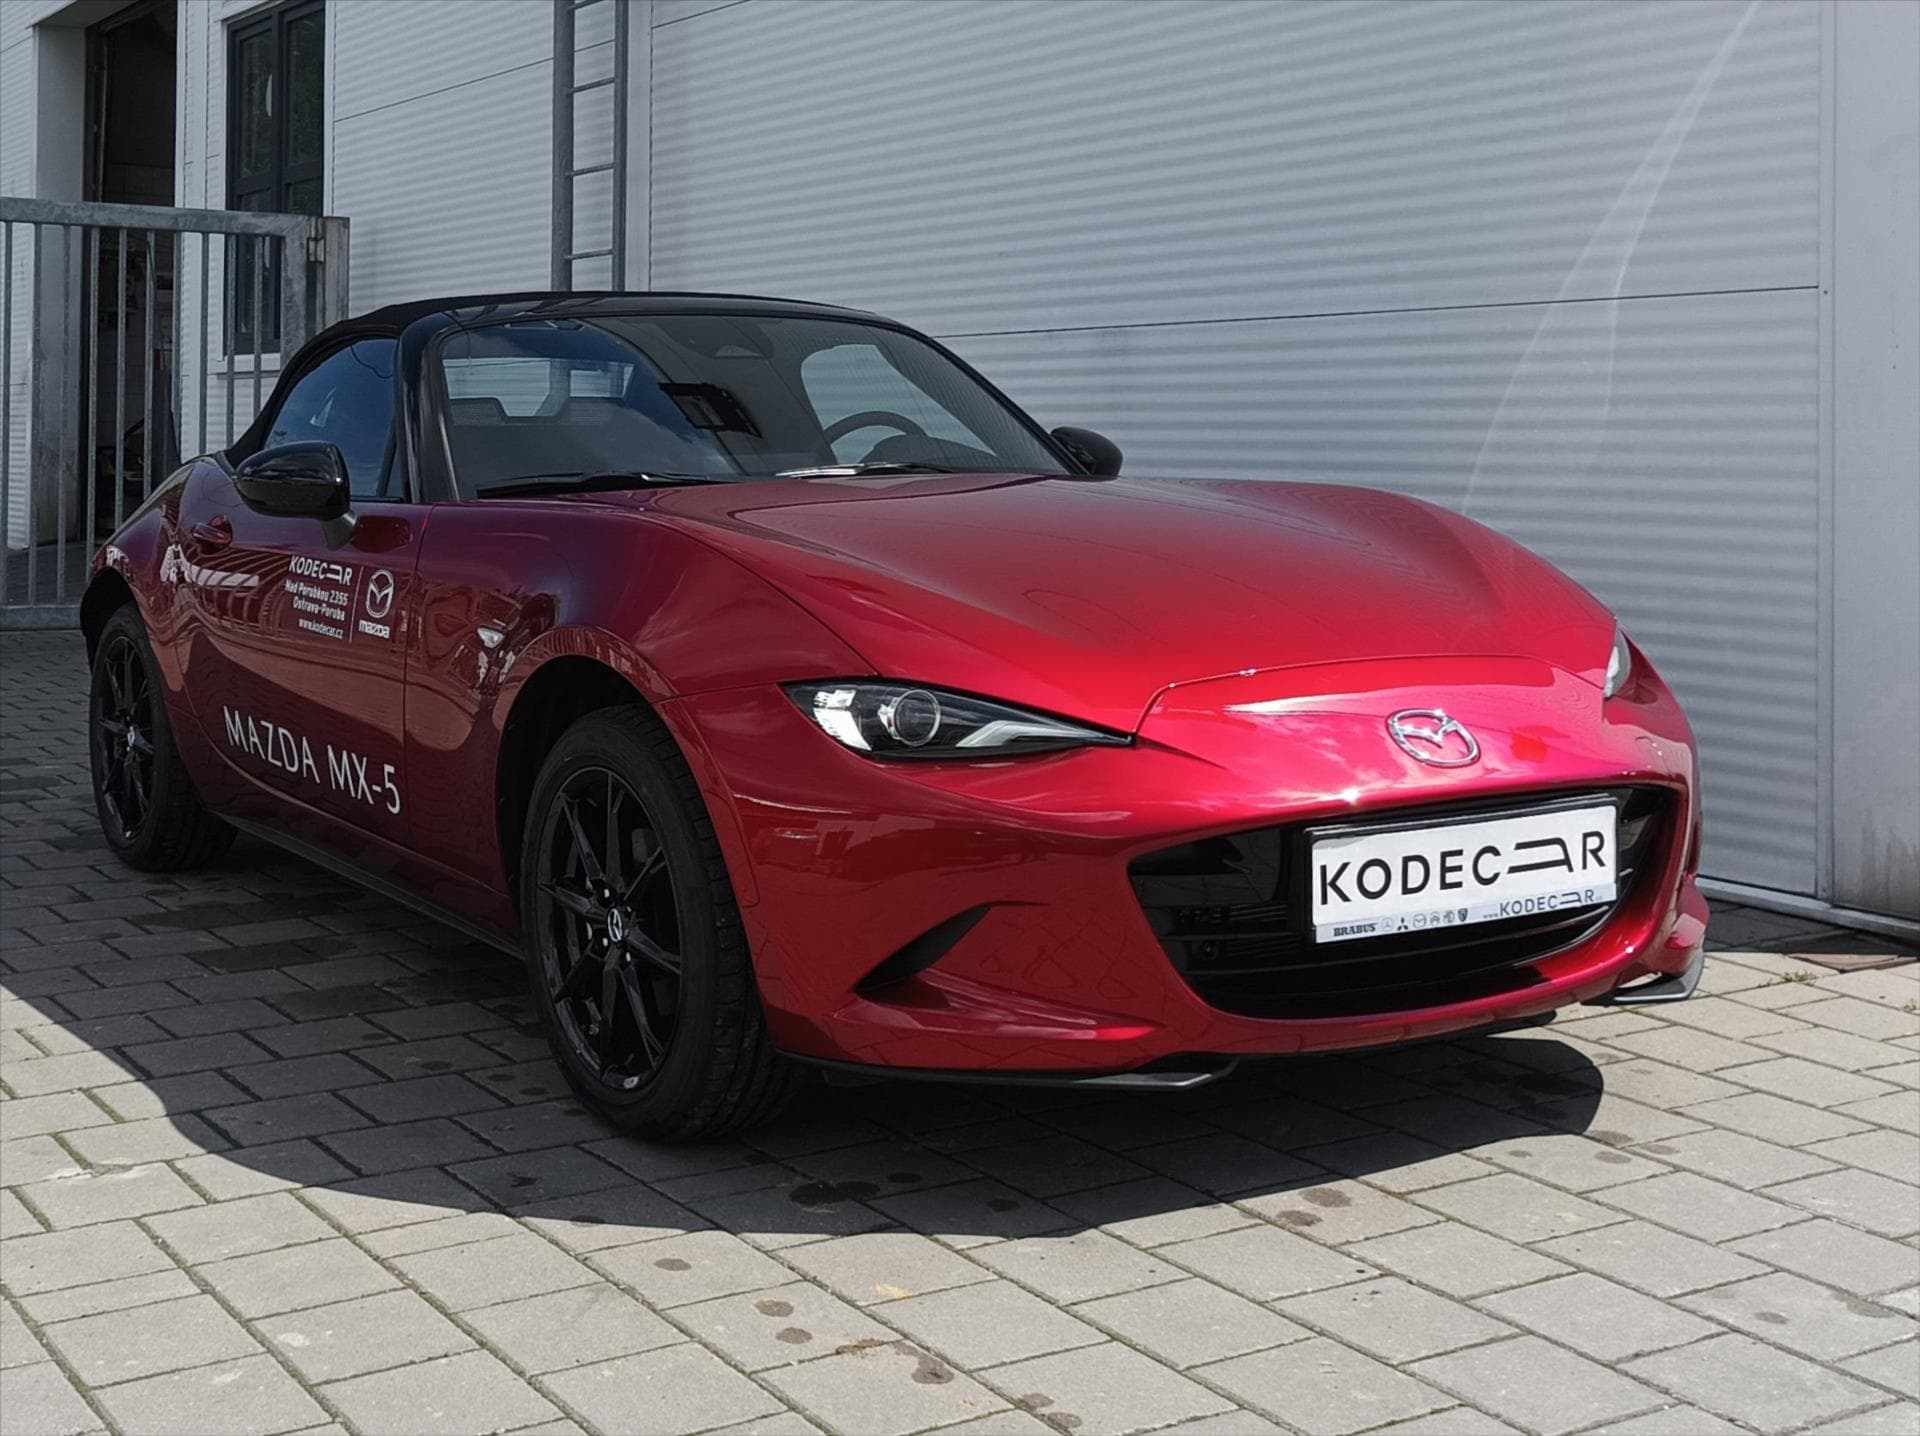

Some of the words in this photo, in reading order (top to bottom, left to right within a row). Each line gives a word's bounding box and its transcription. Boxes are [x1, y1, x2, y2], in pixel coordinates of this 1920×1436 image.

[285, 579, 301, 594] Nad
[358, 620, 390, 639] mazda
[223, 705, 321, 784] MAZDA
[327, 744, 401, 814] MX-5
[1333, 923, 1376, 937] BRABUS
